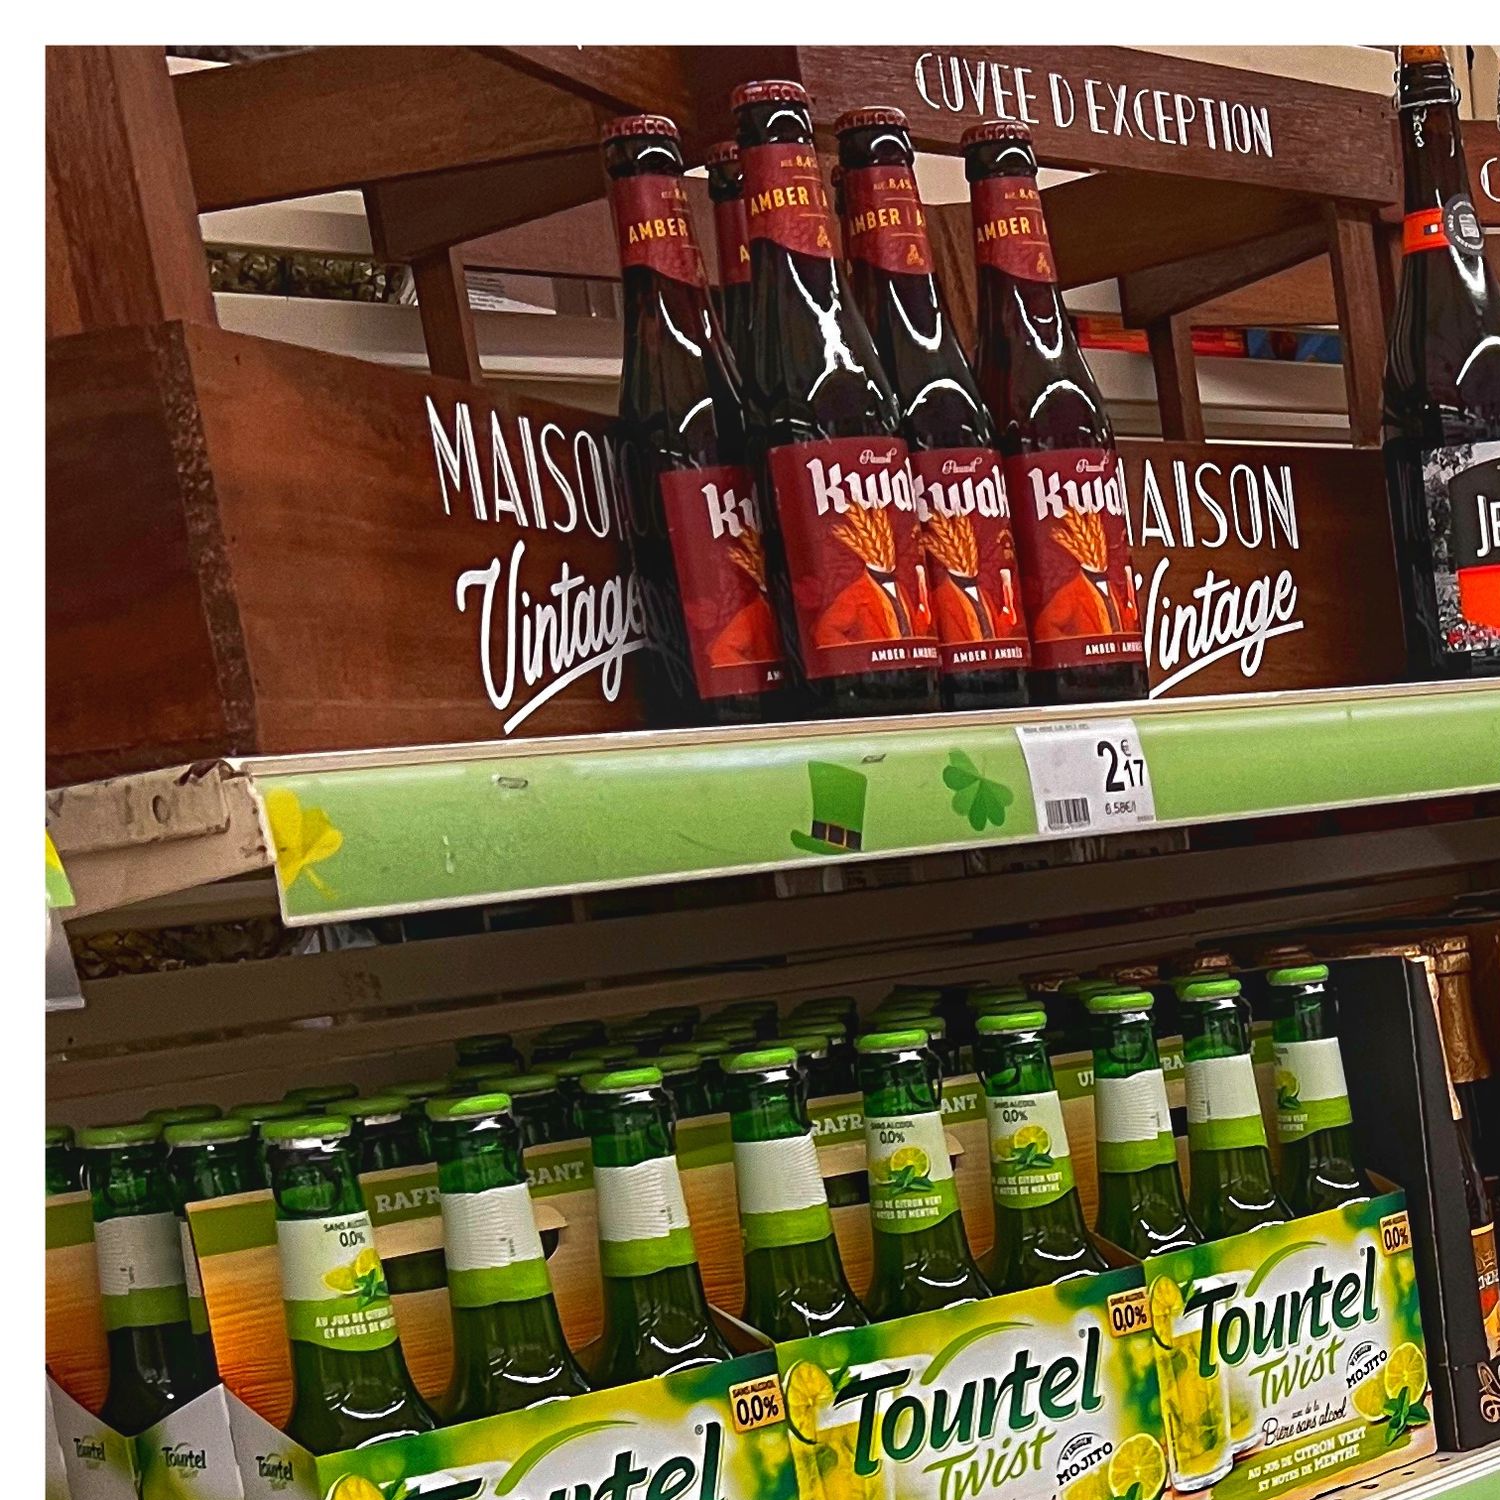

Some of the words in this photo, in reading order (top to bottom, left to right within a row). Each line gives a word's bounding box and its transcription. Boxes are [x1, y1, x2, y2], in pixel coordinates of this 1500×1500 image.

[914, 52, 1039, 125] CUVEE
[1047, 73, 1075, 129] D
[1083, 78, 1273, 158] EXCEPTION
[748, 185, 810, 217] AMBER
[627, 215, 689, 246] AMBER
[871, 650, 905, 662] AMBER
[1181, 1246, 1379, 1380] Tourtel
[1248, 1334, 1346, 1409] Twist
[1346, 1350, 1388, 1388] MOJITO
[831, 1327, 1104, 1478] Tourtel
[1056, 1442, 1113, 1486] MOJITO
